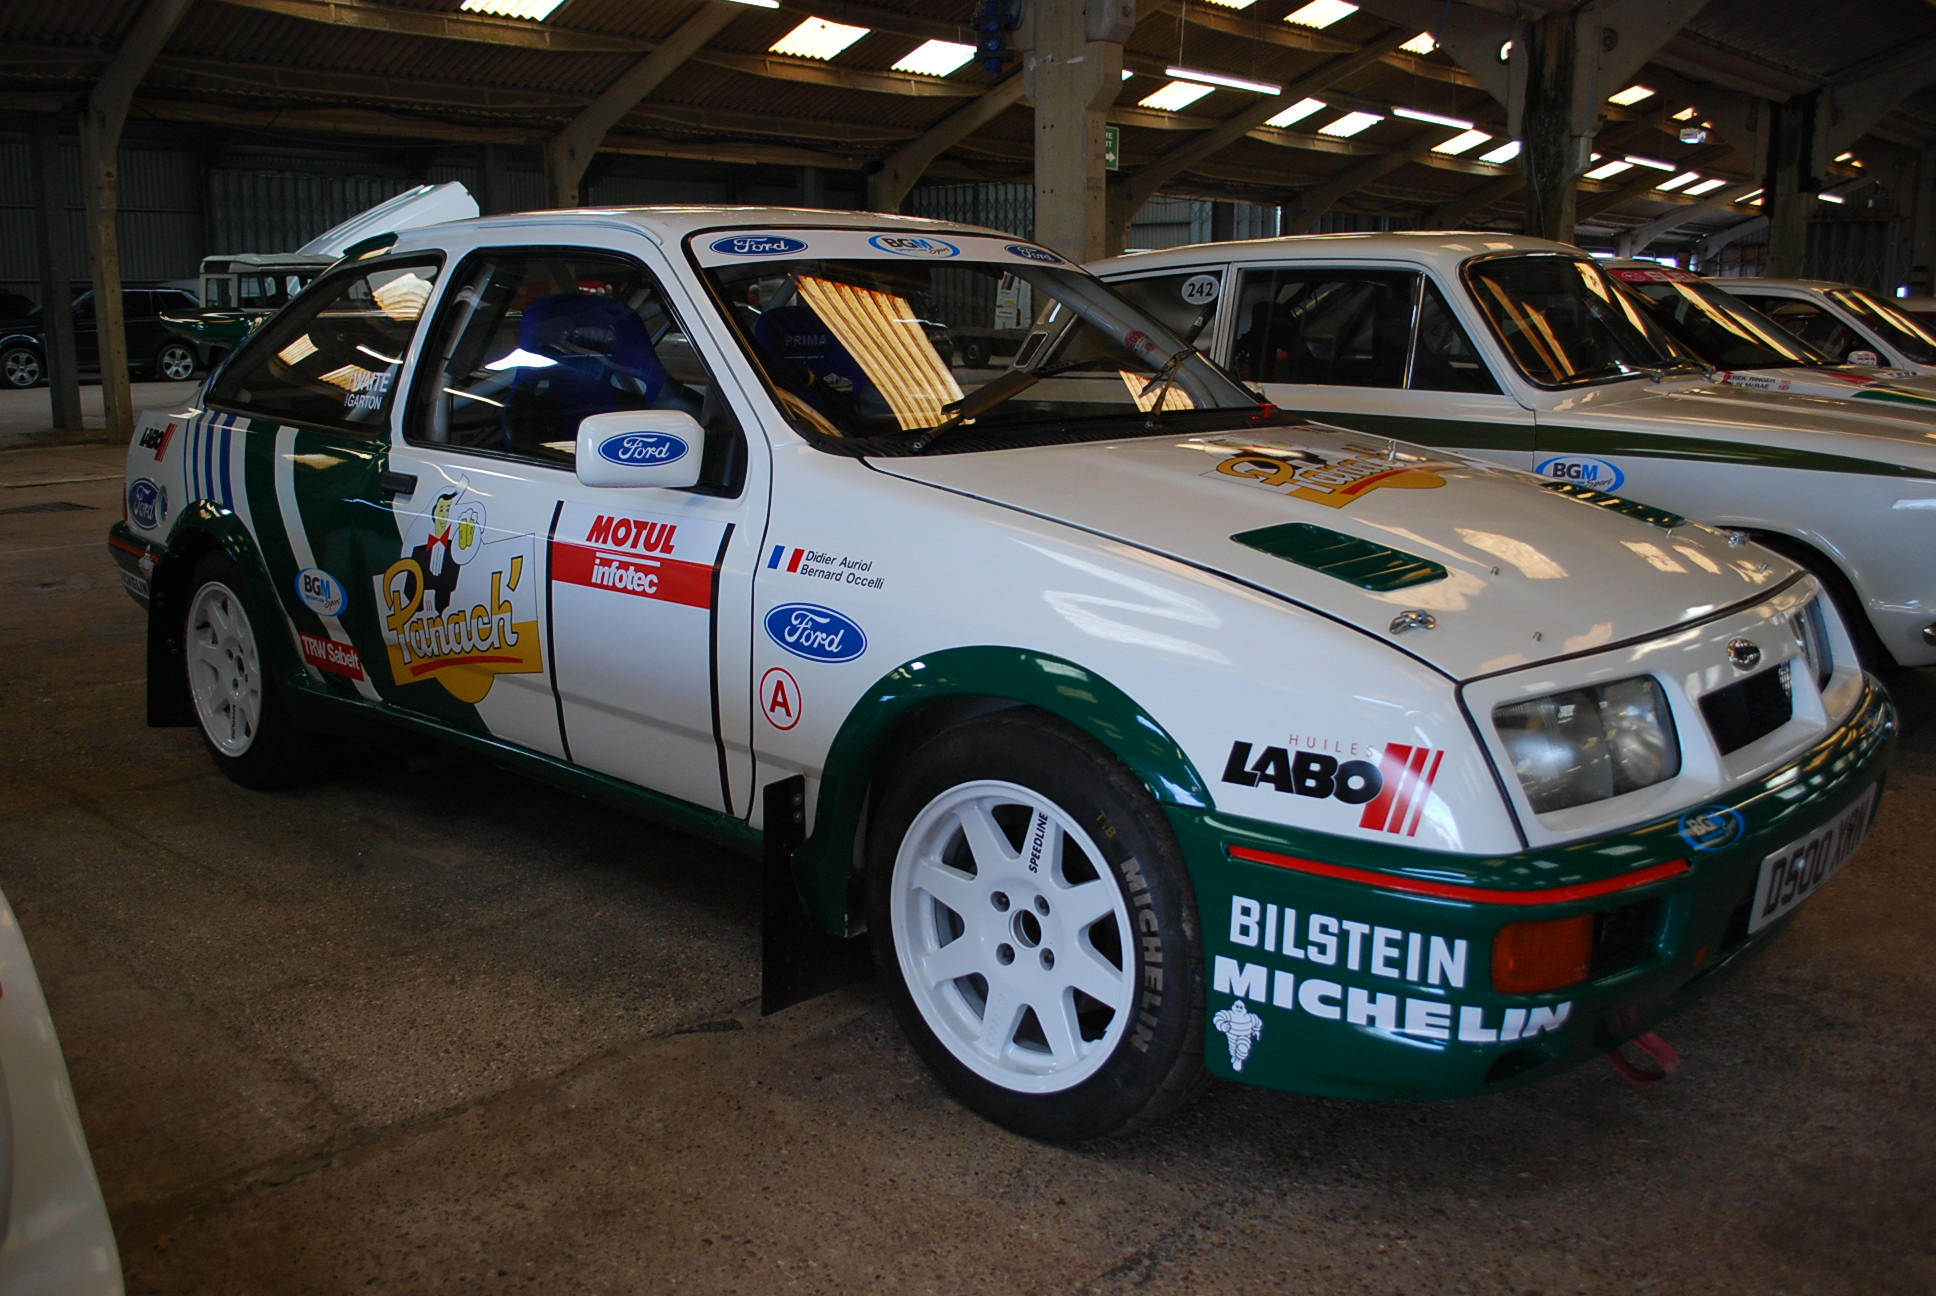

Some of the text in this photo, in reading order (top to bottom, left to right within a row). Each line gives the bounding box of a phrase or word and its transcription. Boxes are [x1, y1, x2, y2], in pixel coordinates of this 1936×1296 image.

[734, 238, 790, 253] Ford
[882, 237, 934, 249] BGM
[1017, 246, 1056, 262] Ford
[1187, 281, 1215, 298] 242
[617, 435, 671, 461] Ford
[1552, 462, 1598, 480] BGM
[133, 485, 155, 521] Ford
[586, 514, 678, 556] MOTUL
[591, 558, 659, 595] infotec
[800, 564, 886, 591] Bernard Occelli
[804, 550, 873, 573] Didier Auriol
[303, 574, 331, 598] BGM
[784, 611, 844, 654] Ford
[302, 635, 360, 671] TRW Sabelt
[768, 680, 793, 718] A
[1288, 733, 1374, 758] HUILES
[1221, 740, 1384, 806] LABO
[1028, 811, 1050, 874] SPEEDLINE
[1120, 856, 1164, 1054] MICHELIN
[1229, 894, 1470, 990] BILSTEIN
[1213, 954, 1572, 1044] MICHELIN
